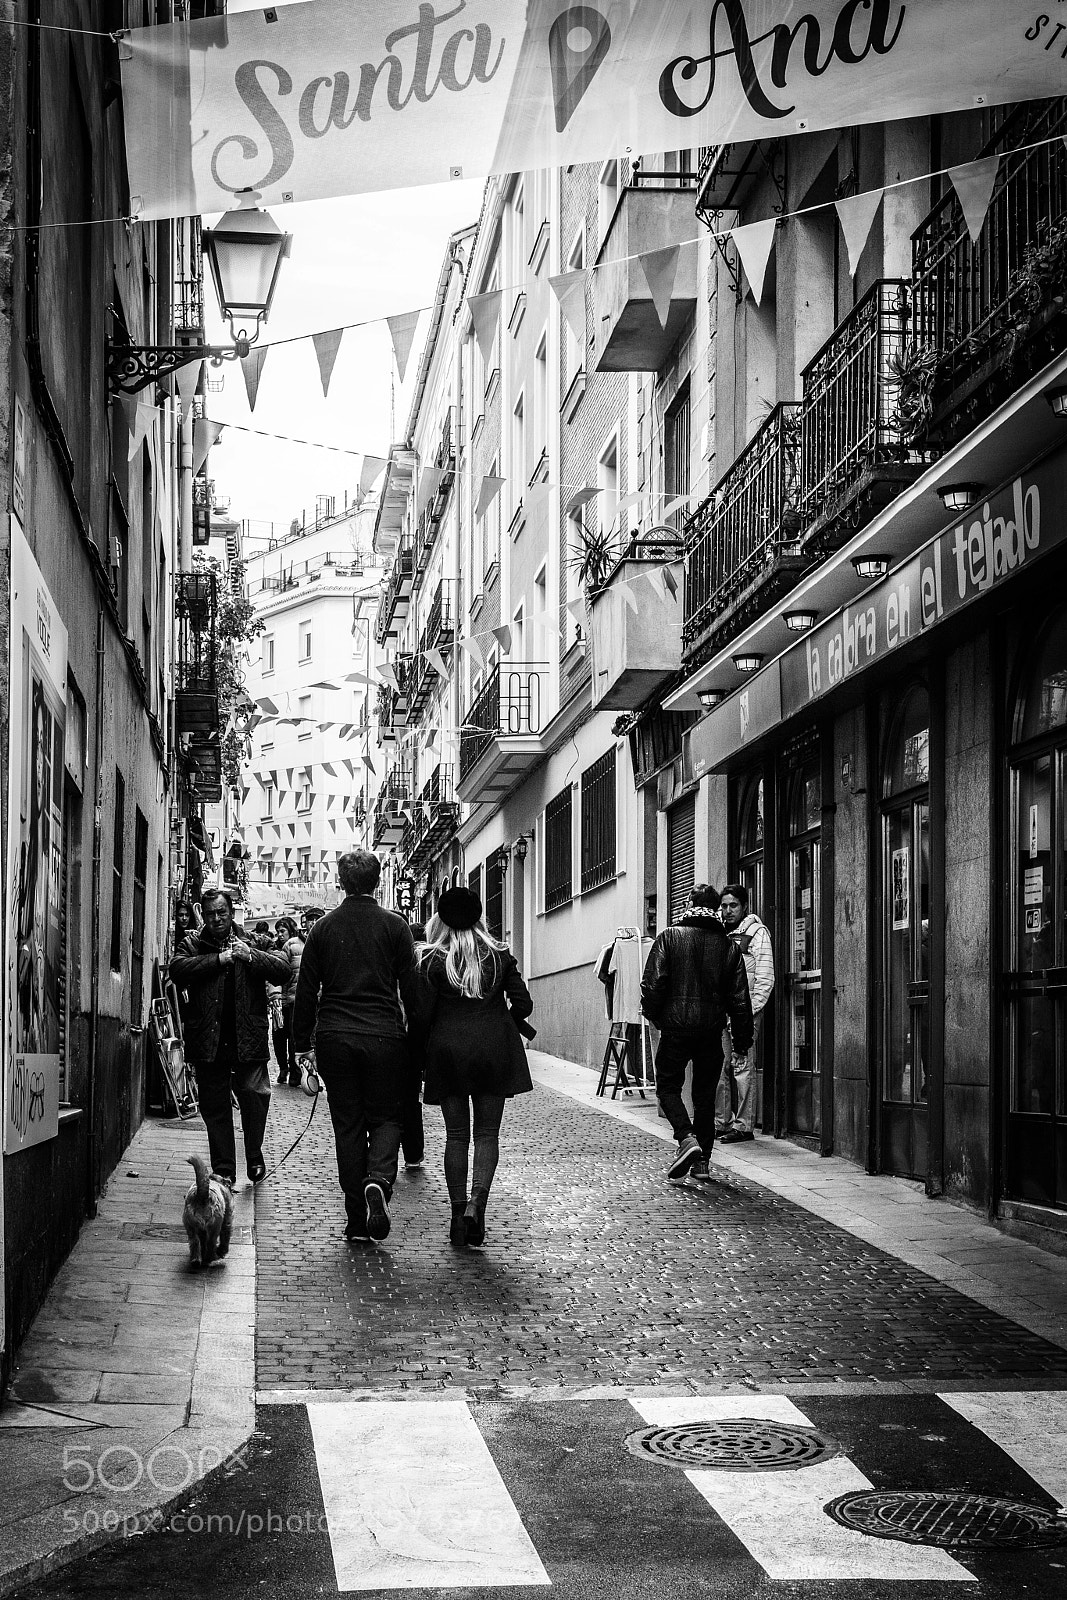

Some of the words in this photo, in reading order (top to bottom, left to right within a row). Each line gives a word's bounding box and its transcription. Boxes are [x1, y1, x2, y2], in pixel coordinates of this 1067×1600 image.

[210, 0, 506, 193] Santa
[658, 0, 905, 119] Ana
[806, 637, 820, 698] la
[828, 606, 876, 684] cabra
[886, 584, 910, 649] en
[921, 538, 944, 626] el
[952, 478, 1041, 599] tejado
[400, 881, 412, 907] BAR
